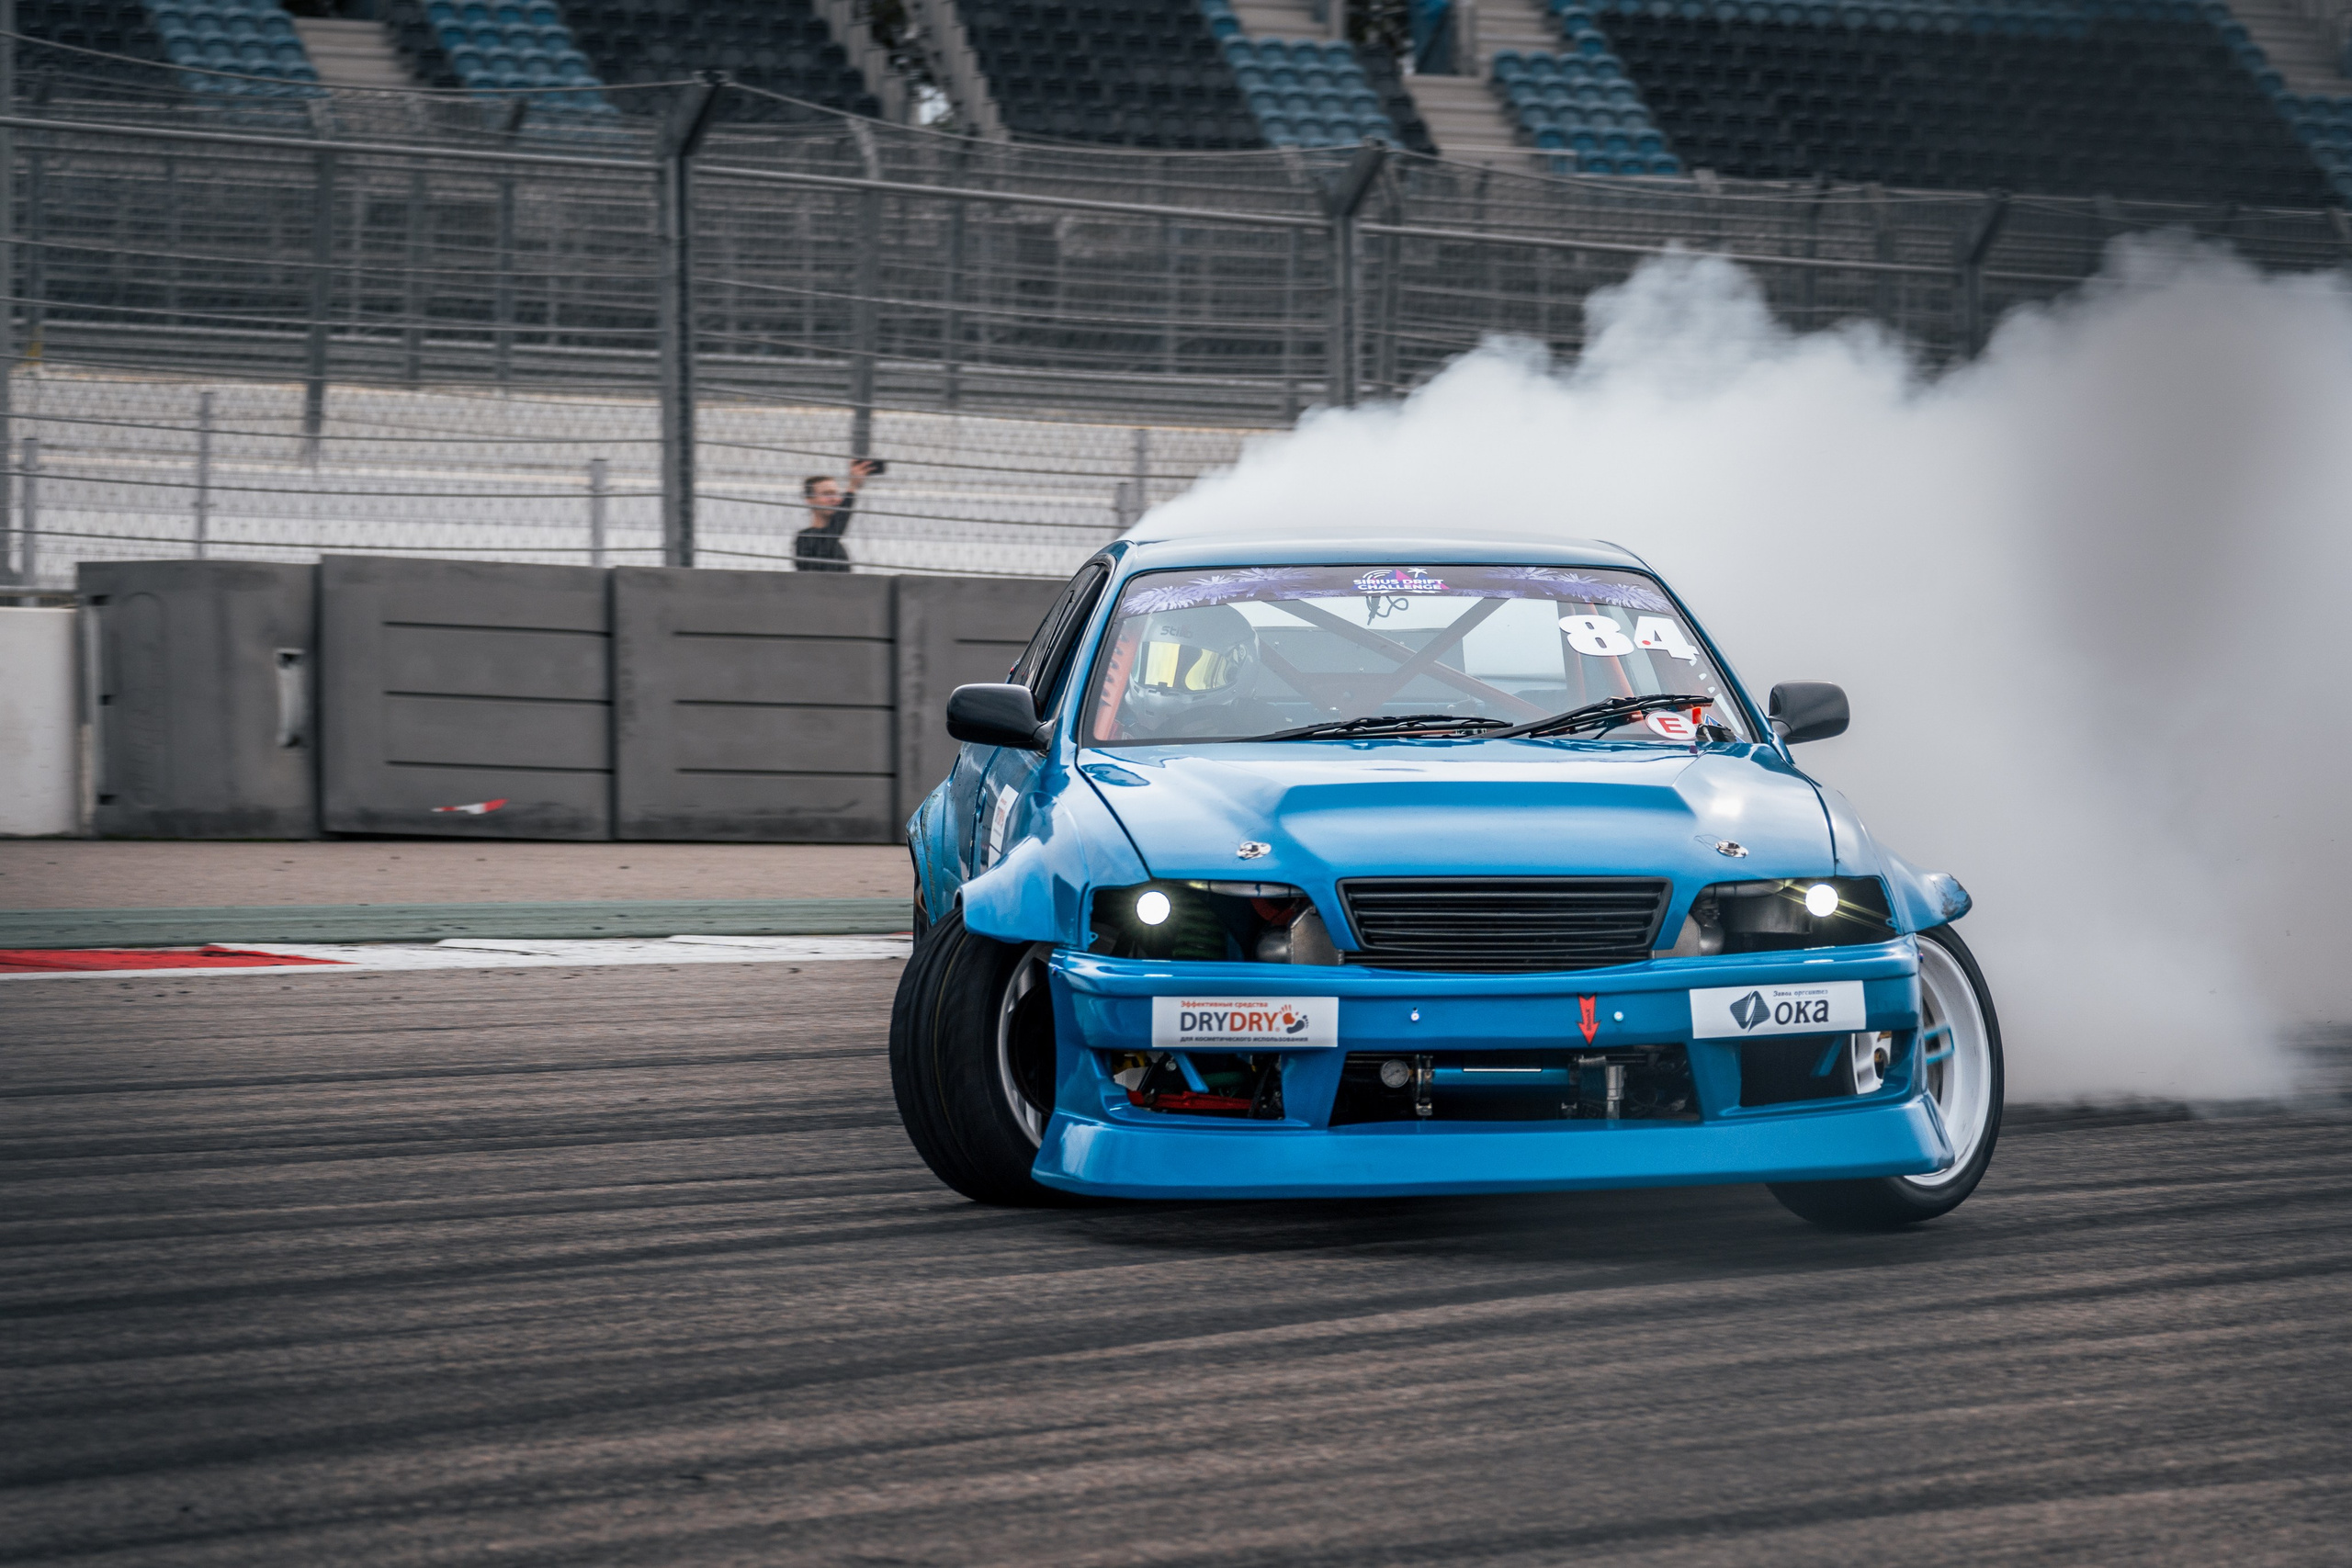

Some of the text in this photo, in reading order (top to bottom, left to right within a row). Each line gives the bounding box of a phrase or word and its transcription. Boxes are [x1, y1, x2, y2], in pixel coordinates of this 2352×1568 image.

[1558, 615, 1700, 660] 84
[1656, 716, 1689, 734] E
[1181, 1000, 1233, 1009] Эффективные
